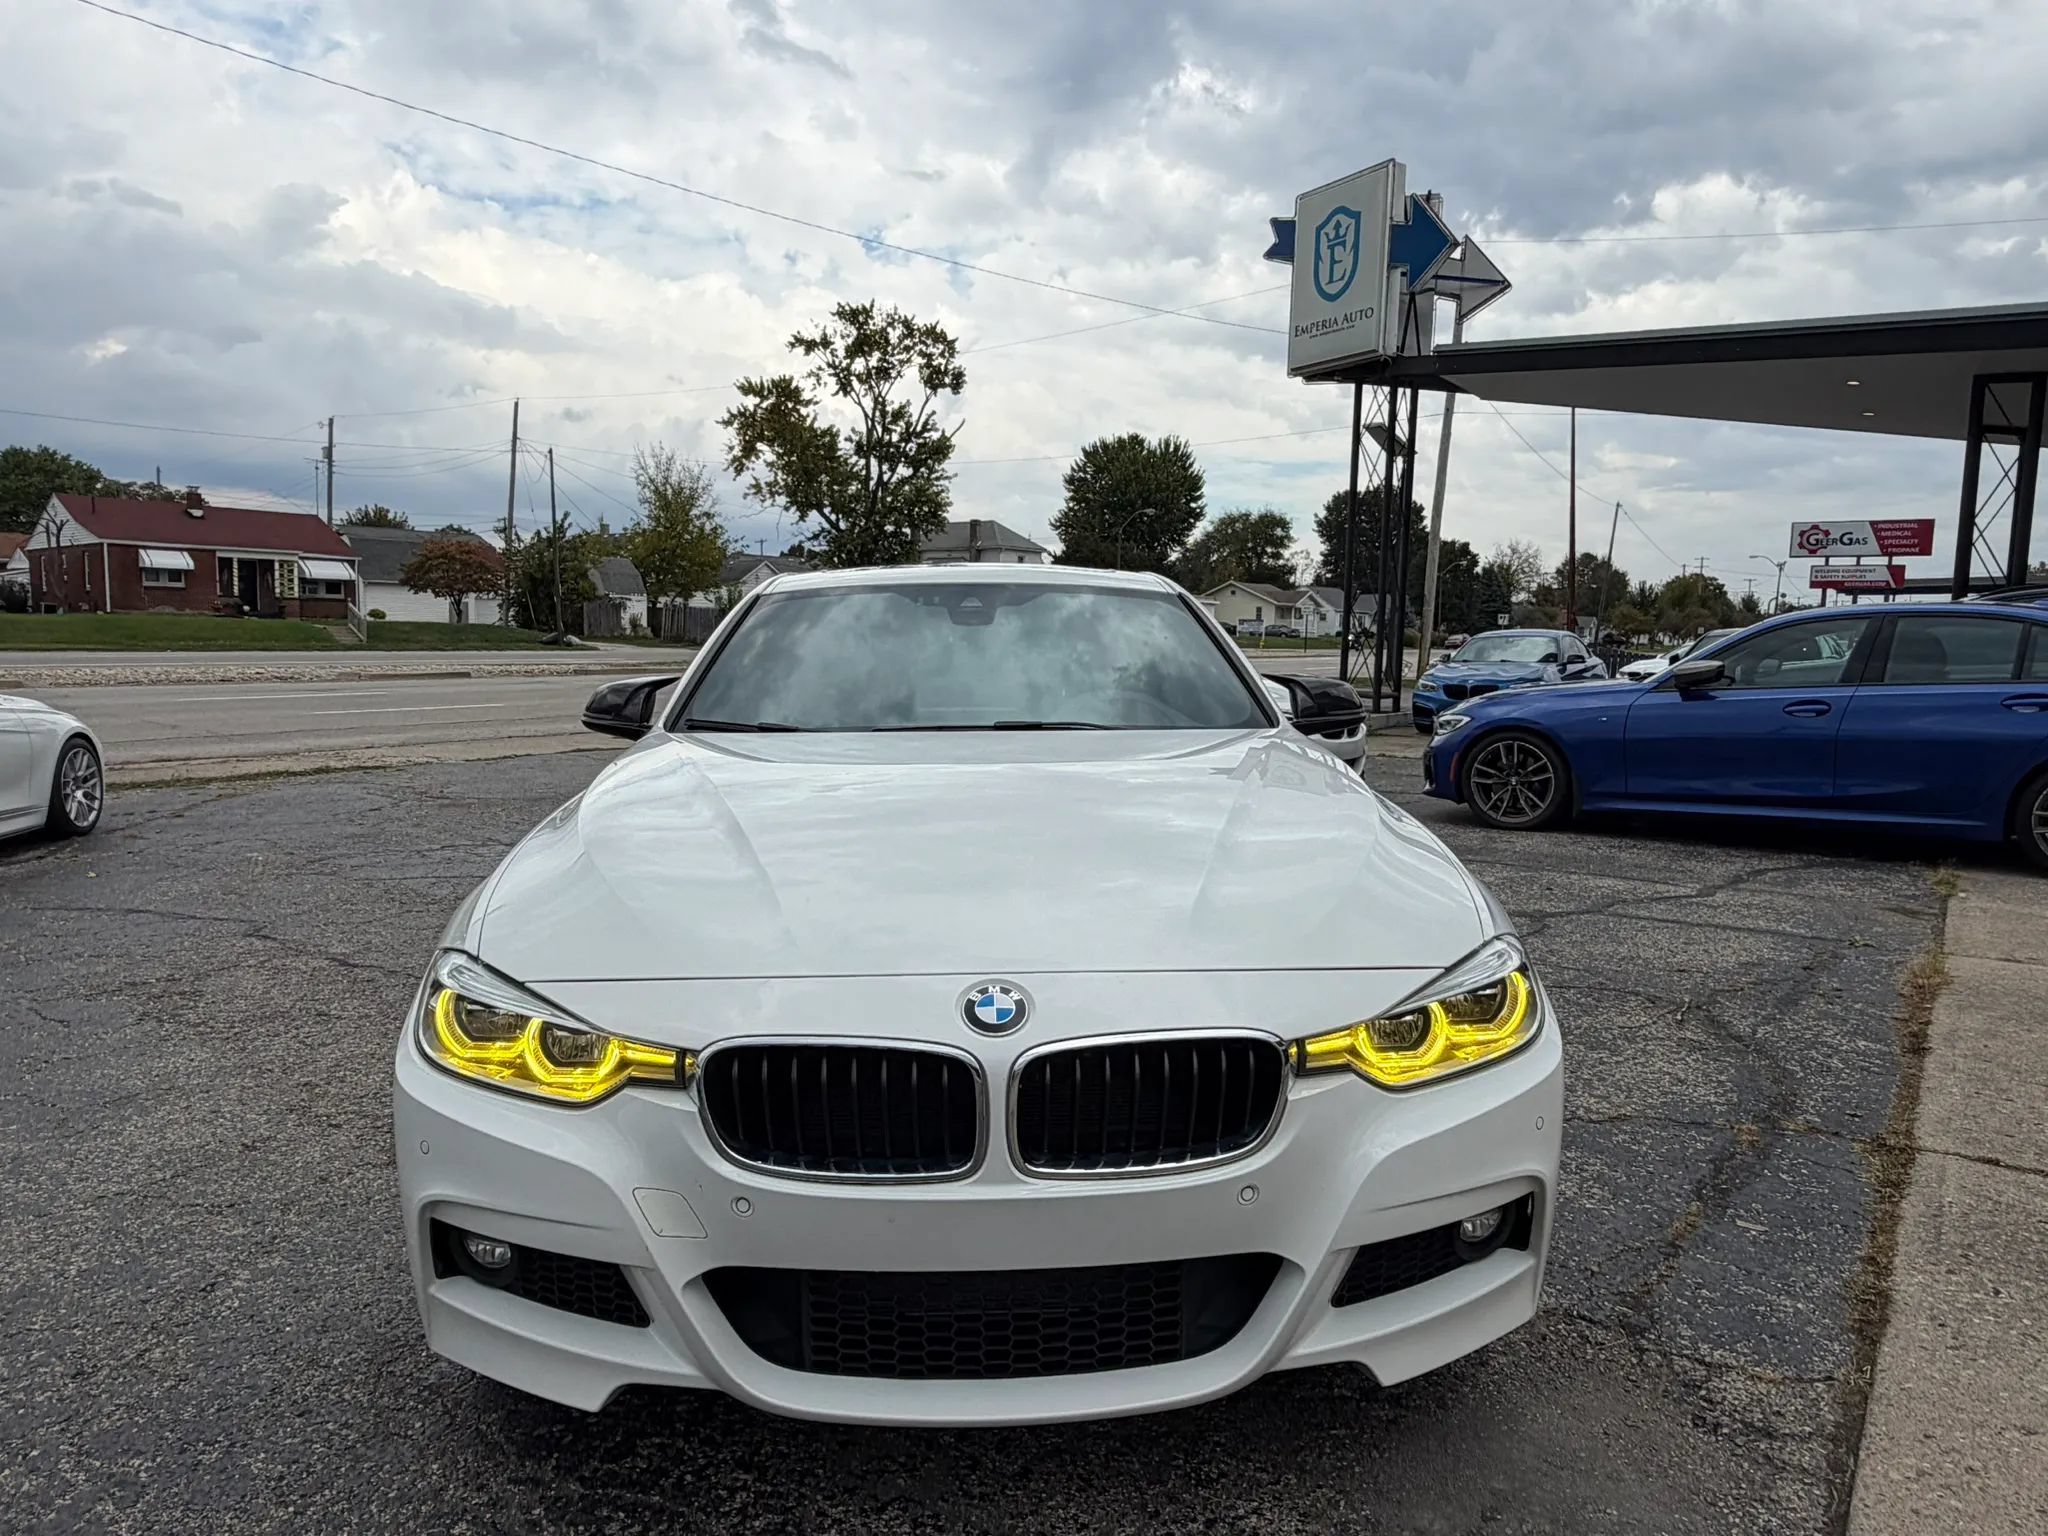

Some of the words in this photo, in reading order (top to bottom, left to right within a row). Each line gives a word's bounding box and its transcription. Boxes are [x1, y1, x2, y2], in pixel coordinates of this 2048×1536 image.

[1294, 316, 1339, 338] EMPERIA
[1341, 306, 1374, 326] AUTO
[968, 985, 1022, 1002] BMW
